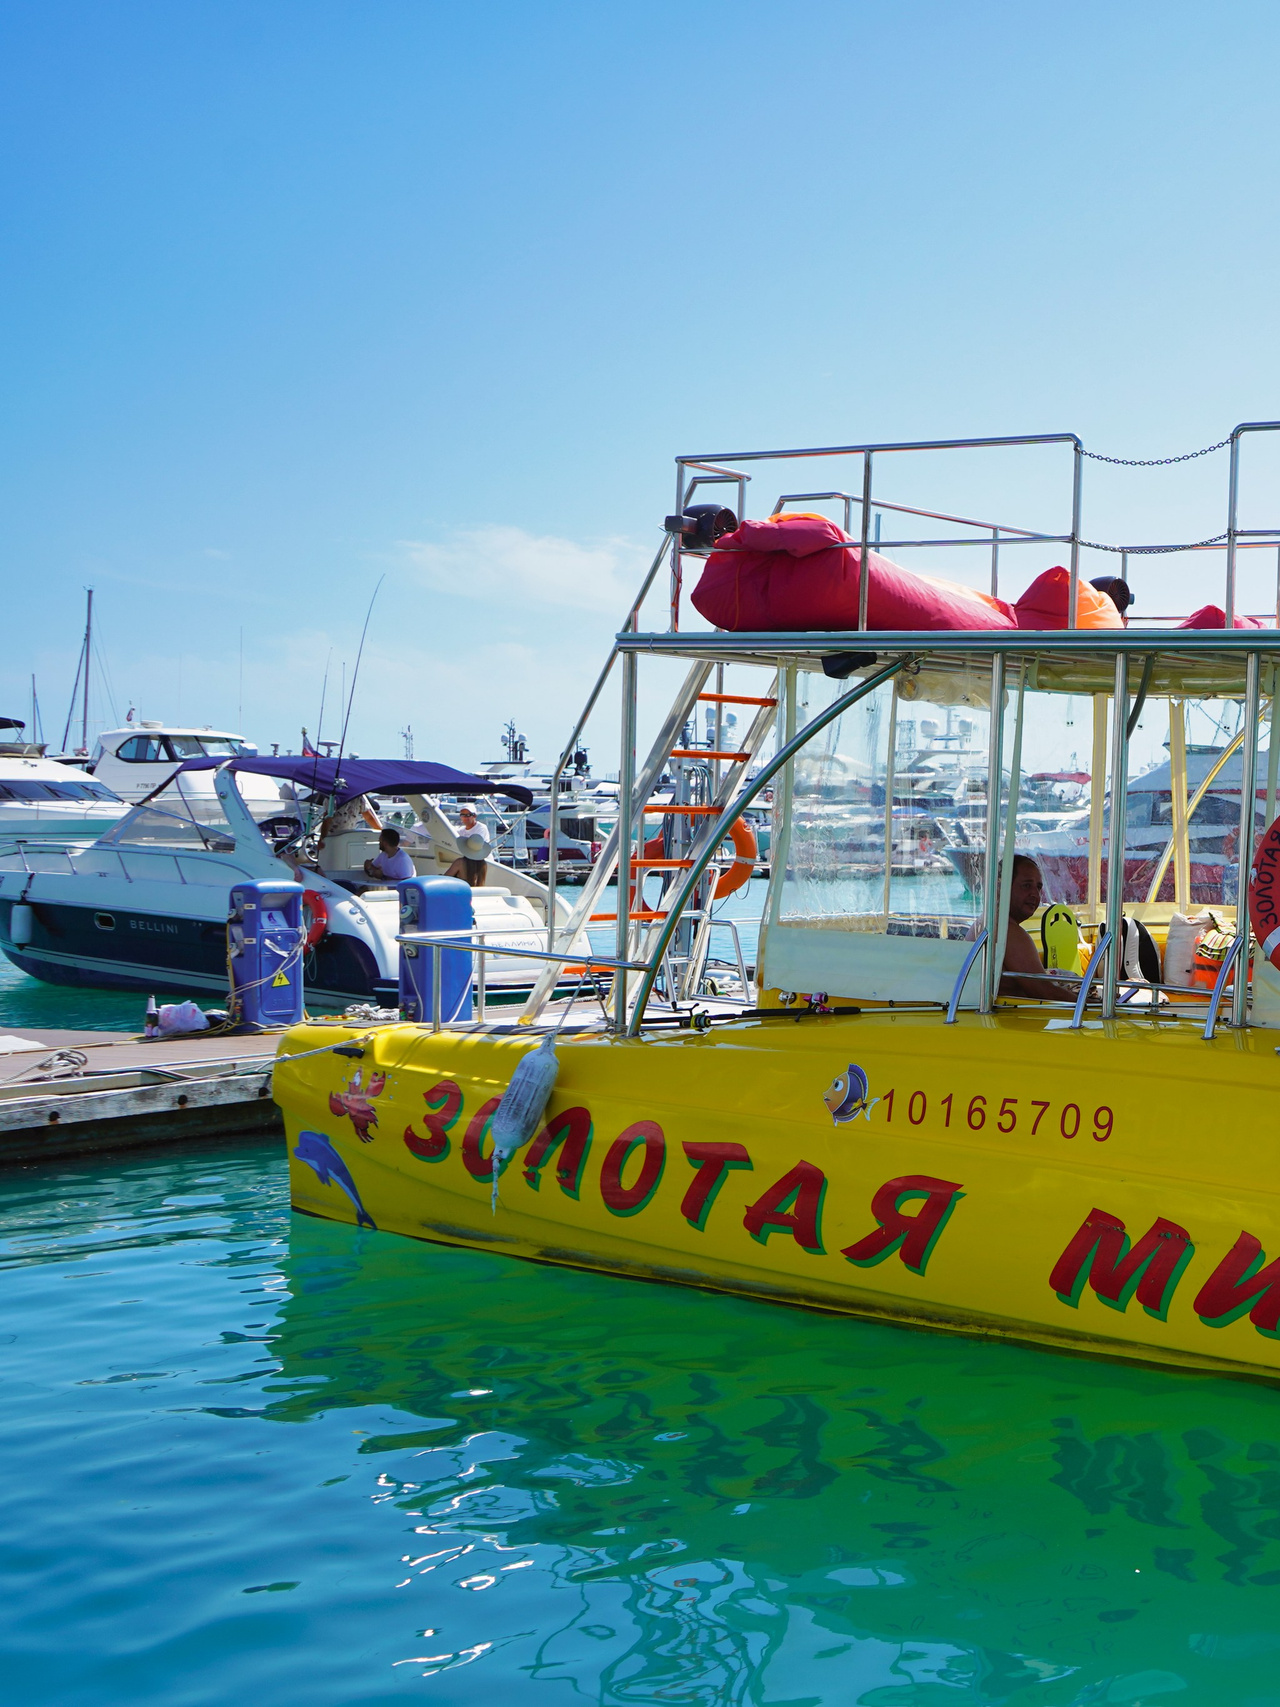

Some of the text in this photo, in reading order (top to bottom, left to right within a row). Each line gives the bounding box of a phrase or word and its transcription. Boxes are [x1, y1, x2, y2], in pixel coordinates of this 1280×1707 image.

[129, 919, 179, 935] BELLINI
[882, 1088, 1114, 1142] 10165709
[404, 1079, 967, 1276] ЗОЛОТАЯ
